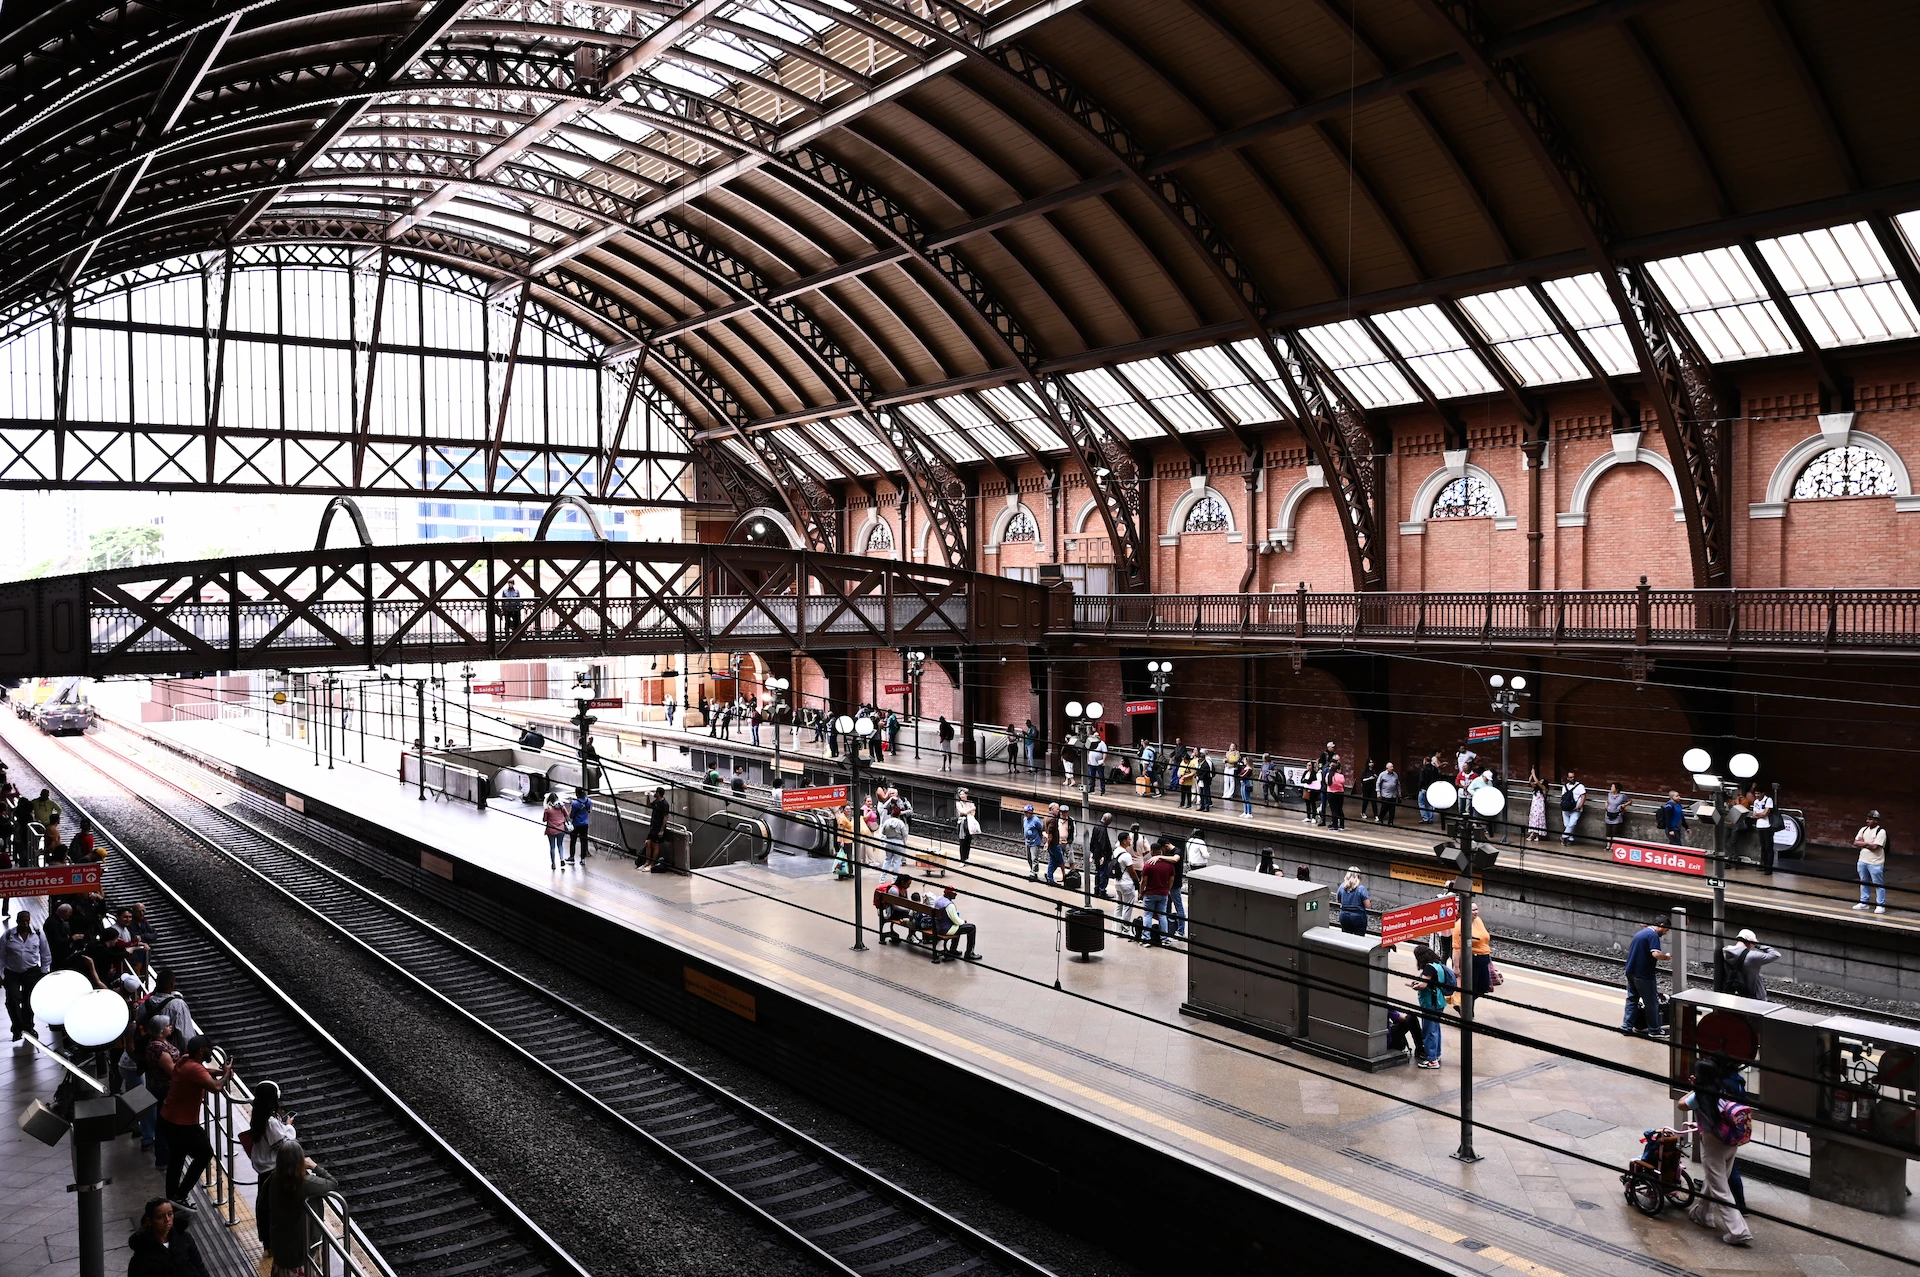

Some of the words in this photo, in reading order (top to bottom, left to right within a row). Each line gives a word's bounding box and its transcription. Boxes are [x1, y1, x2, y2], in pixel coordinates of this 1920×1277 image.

[1645, 852, 1685, 868] Saída
[1383, 922, 1407, 932] Palmeiras
[1410, 917, 1422, 926] Barra
[1423, 913, 1438, 923] Funda
